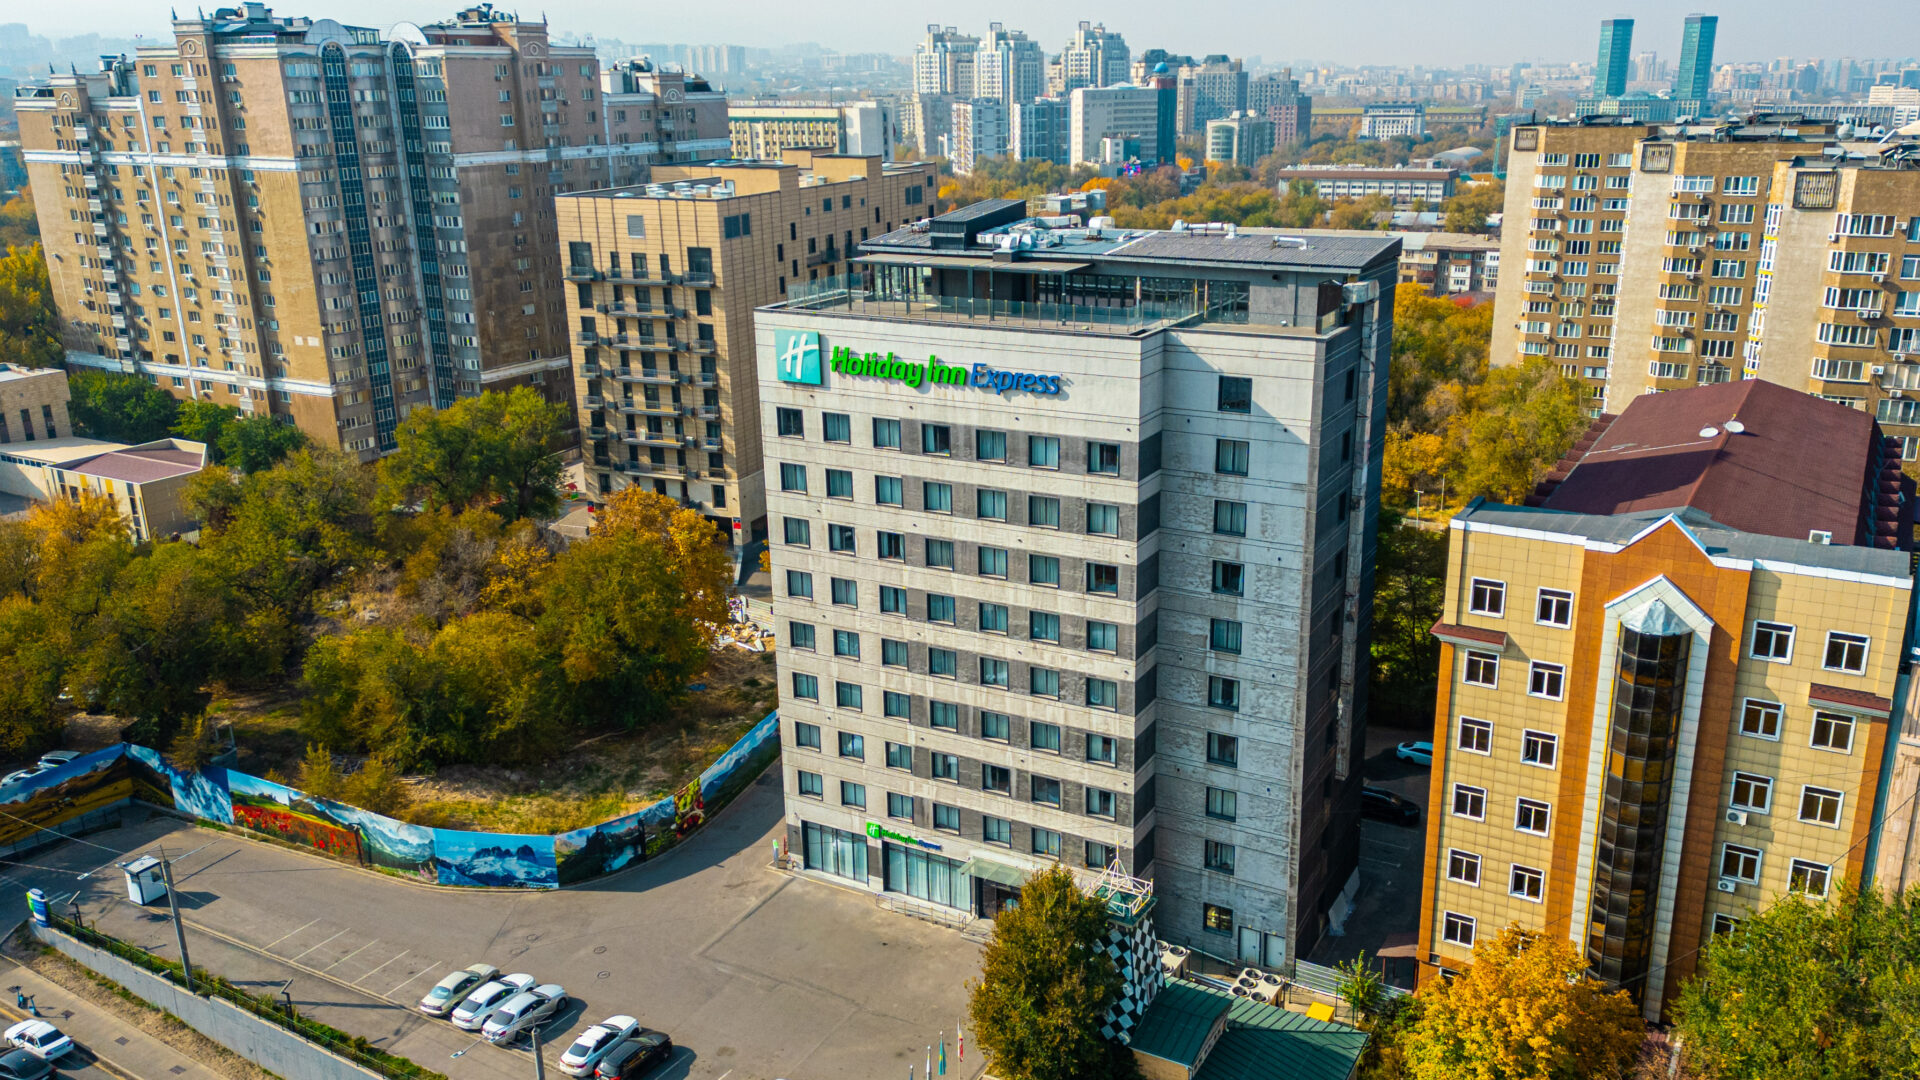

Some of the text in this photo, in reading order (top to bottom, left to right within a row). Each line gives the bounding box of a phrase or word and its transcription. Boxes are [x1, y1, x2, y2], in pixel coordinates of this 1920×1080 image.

[830, 345, 1061, 396] Holiday Inn Express
